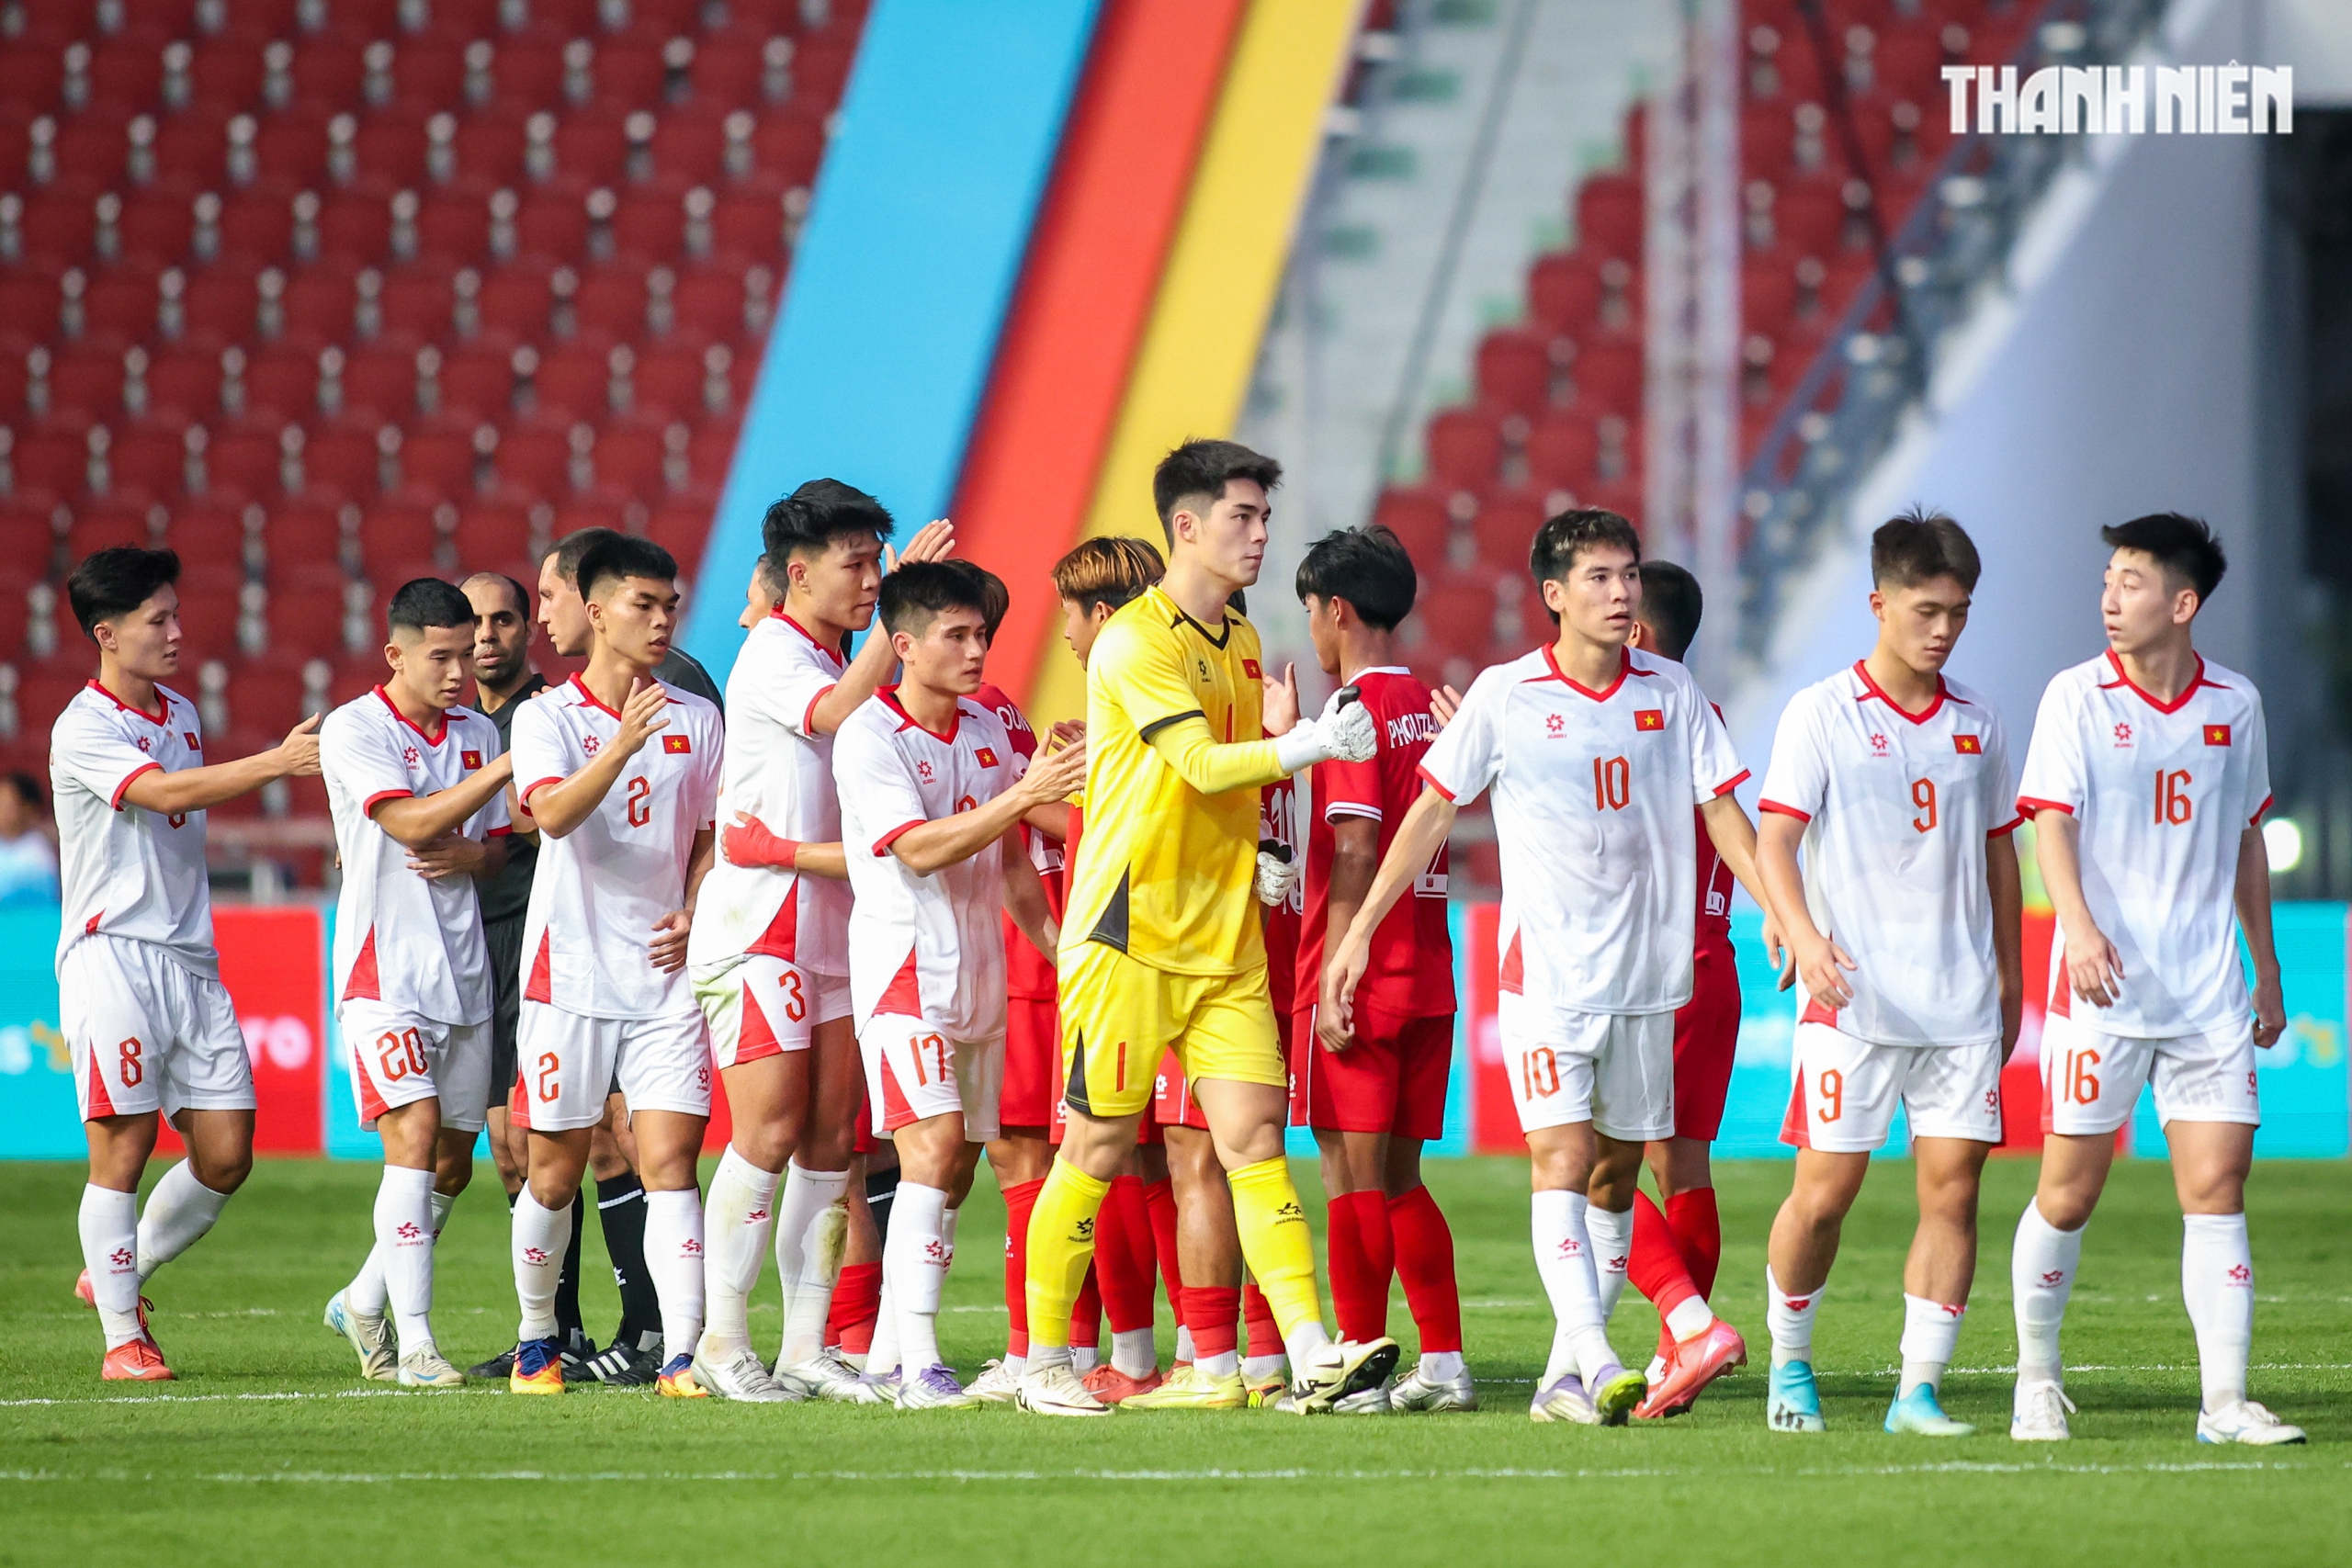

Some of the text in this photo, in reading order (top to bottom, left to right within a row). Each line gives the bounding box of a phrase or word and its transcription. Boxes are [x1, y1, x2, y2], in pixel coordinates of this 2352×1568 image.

[628, 775, 650, 829] 2
[1594, 755, 1630, 812] 10
[1912, 777, 1938, 834] 9
[2154, 769, 2193, 826] 16
[778, 969, 806, 1023] 3
[119, 1036, 142, 1089] 8
[376, 1025, 429, 1082] 20
[537, 1051, 560, 1104] 2
[909, 1033, 946, 1088] 17
[1116, 1042, 1126, 1093] 1
[1522, 1046, 1560, 1102] 10
[2064, 1049, 2101, 1105] 16
[1818, 1068, 1842, 1123] 9
